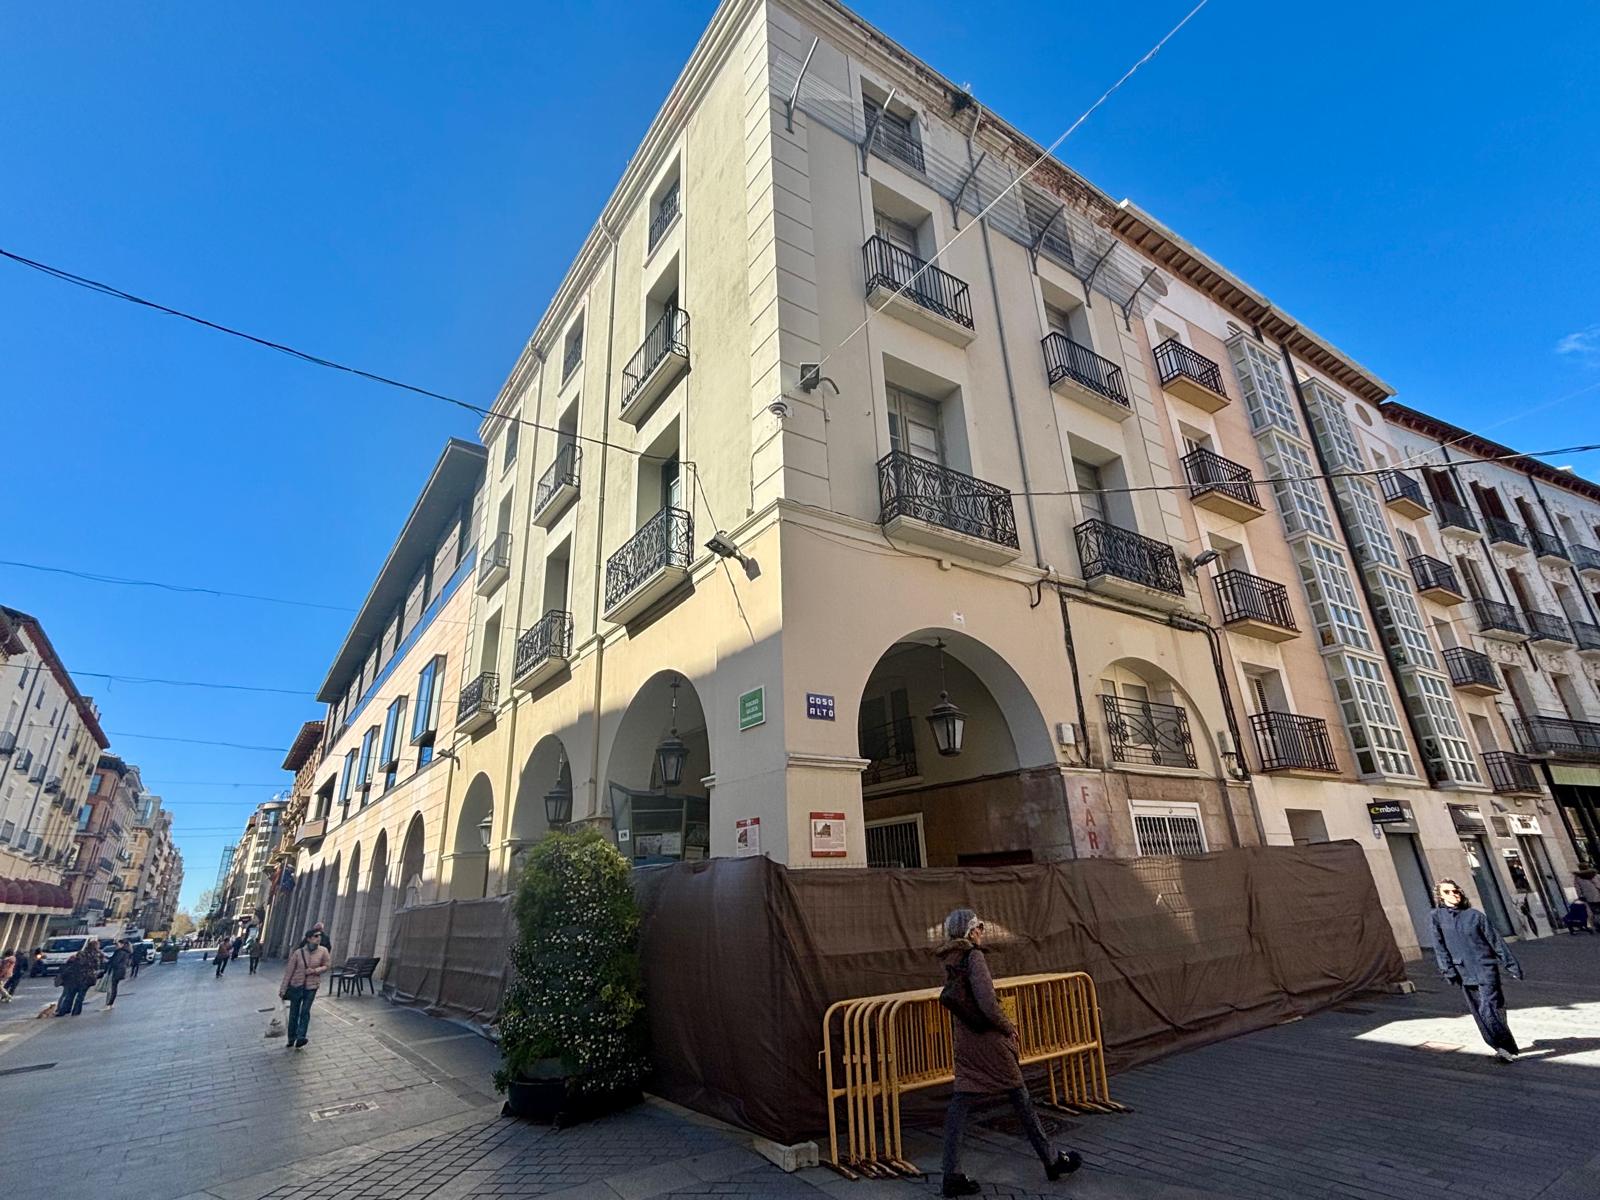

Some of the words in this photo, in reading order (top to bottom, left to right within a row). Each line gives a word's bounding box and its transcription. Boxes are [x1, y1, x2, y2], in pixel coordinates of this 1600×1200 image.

[809, 697, 833, 706] COSO
[809, 707, 834, 717] ALTO
[1081, 786, 1103, 859] FAR
